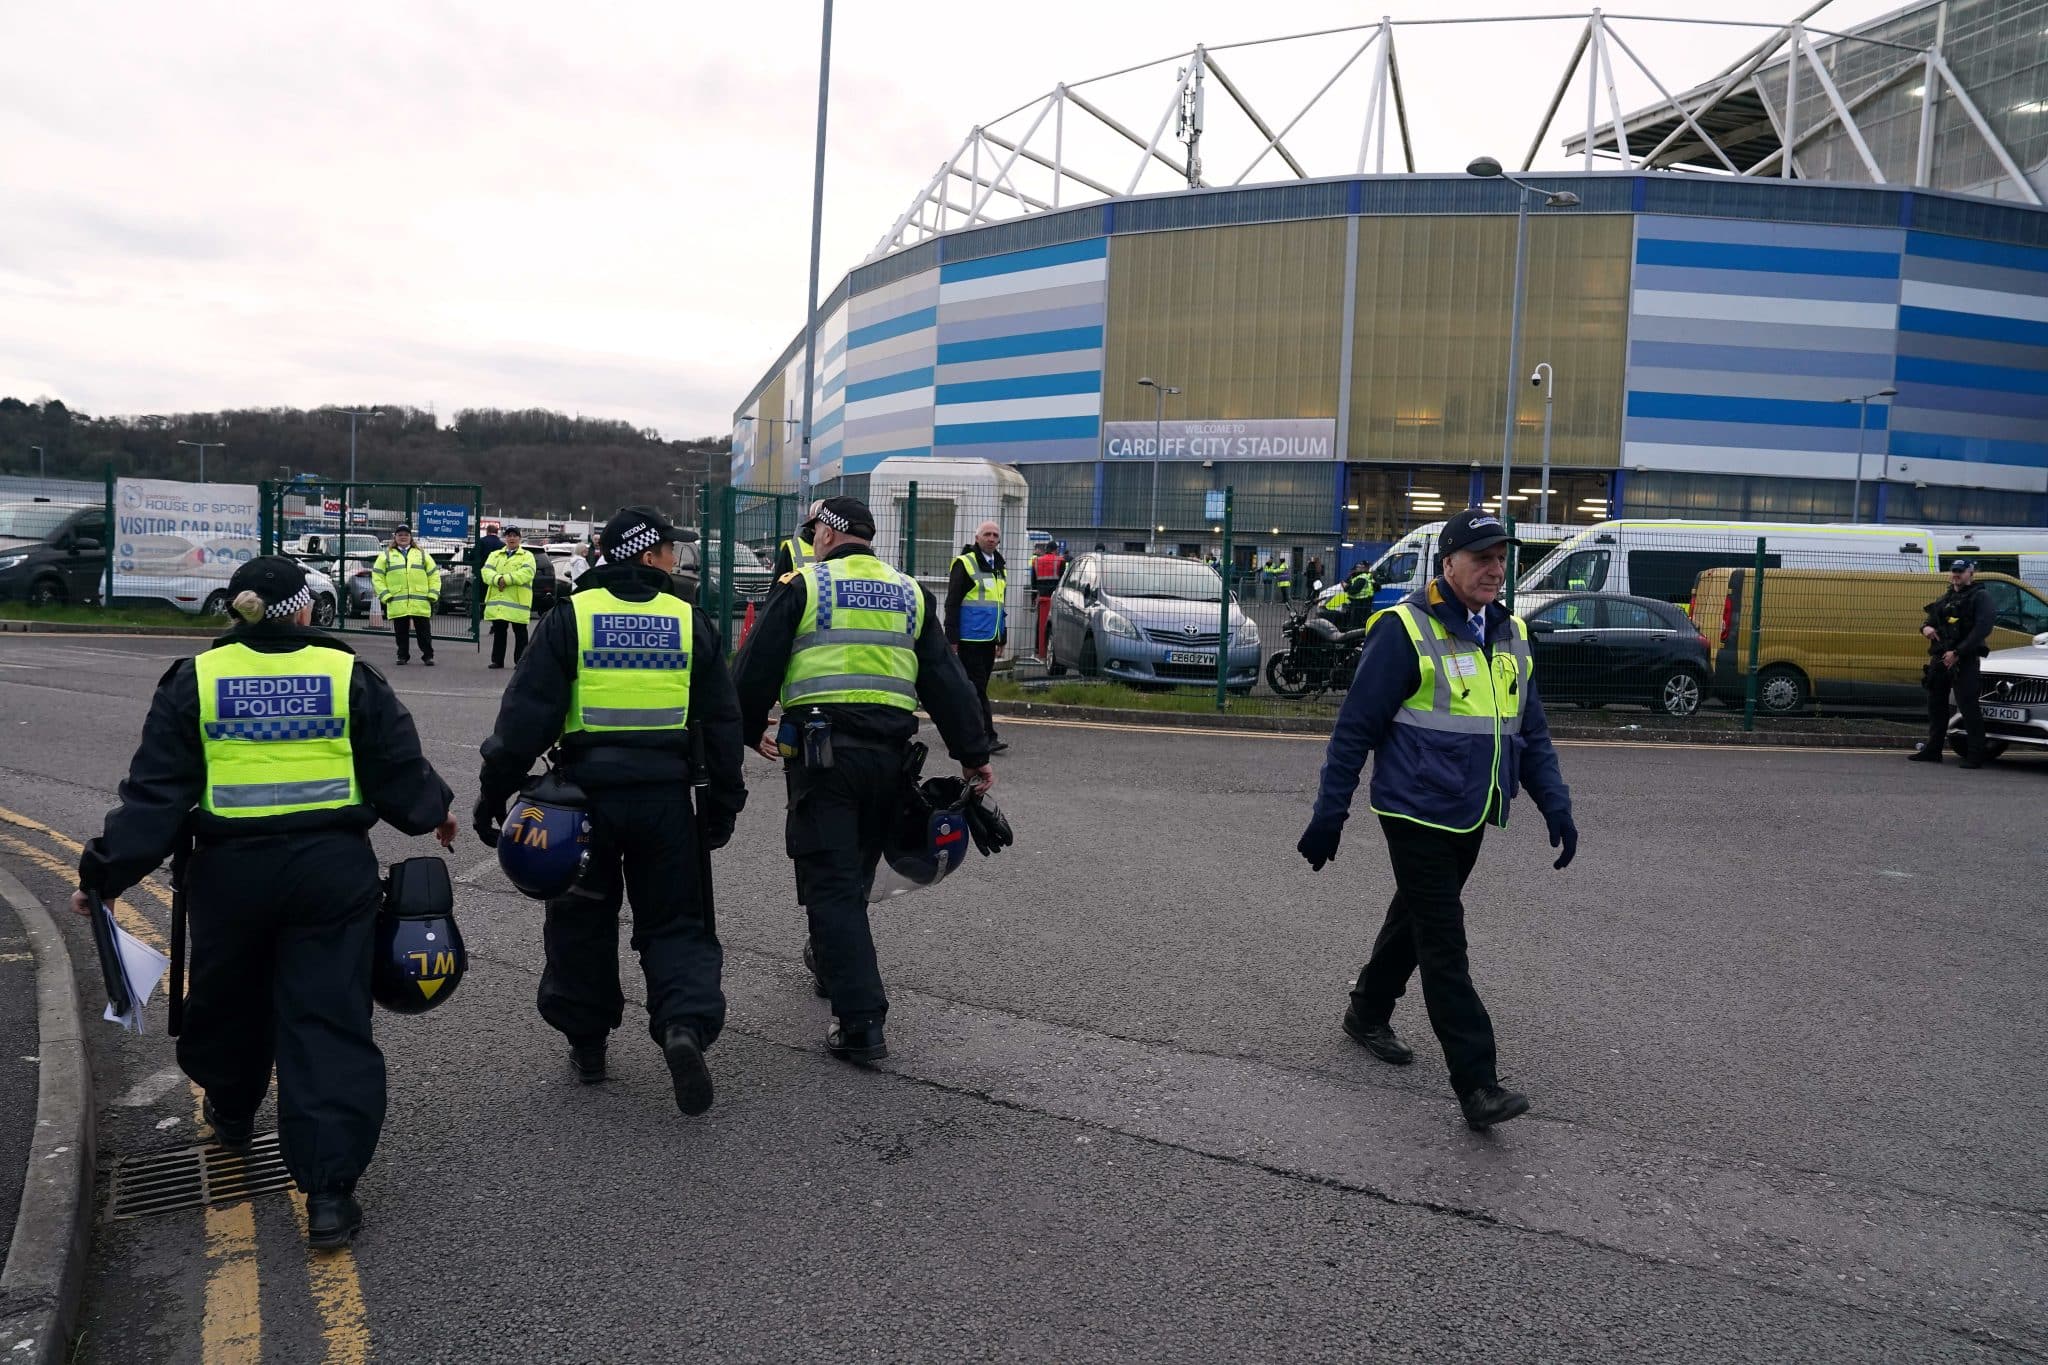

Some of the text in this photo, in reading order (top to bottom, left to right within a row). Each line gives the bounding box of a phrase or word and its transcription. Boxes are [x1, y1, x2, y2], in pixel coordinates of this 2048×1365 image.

[1185, 423, 1246, 434] WELCOME TO
[1108, 436, 1328, 457] CARDIFF CITY STADIUM
[145, 499, 254, 515] HOUSE OF SPORT
[120, 516, 254, 540] VISITOR CAR PARK
[621, 521, 648, 540] HEDDLU
[842, 581, 899, 597] HEDDLU
[847, 594, 899, 610] POLICE
[601, 616, 672, 631] HEDDLU
[606, 632, 670, 648] POLICE
[228, 678, 321, 696] HEDDLU
[234, 698, 317, 716] POLICE
